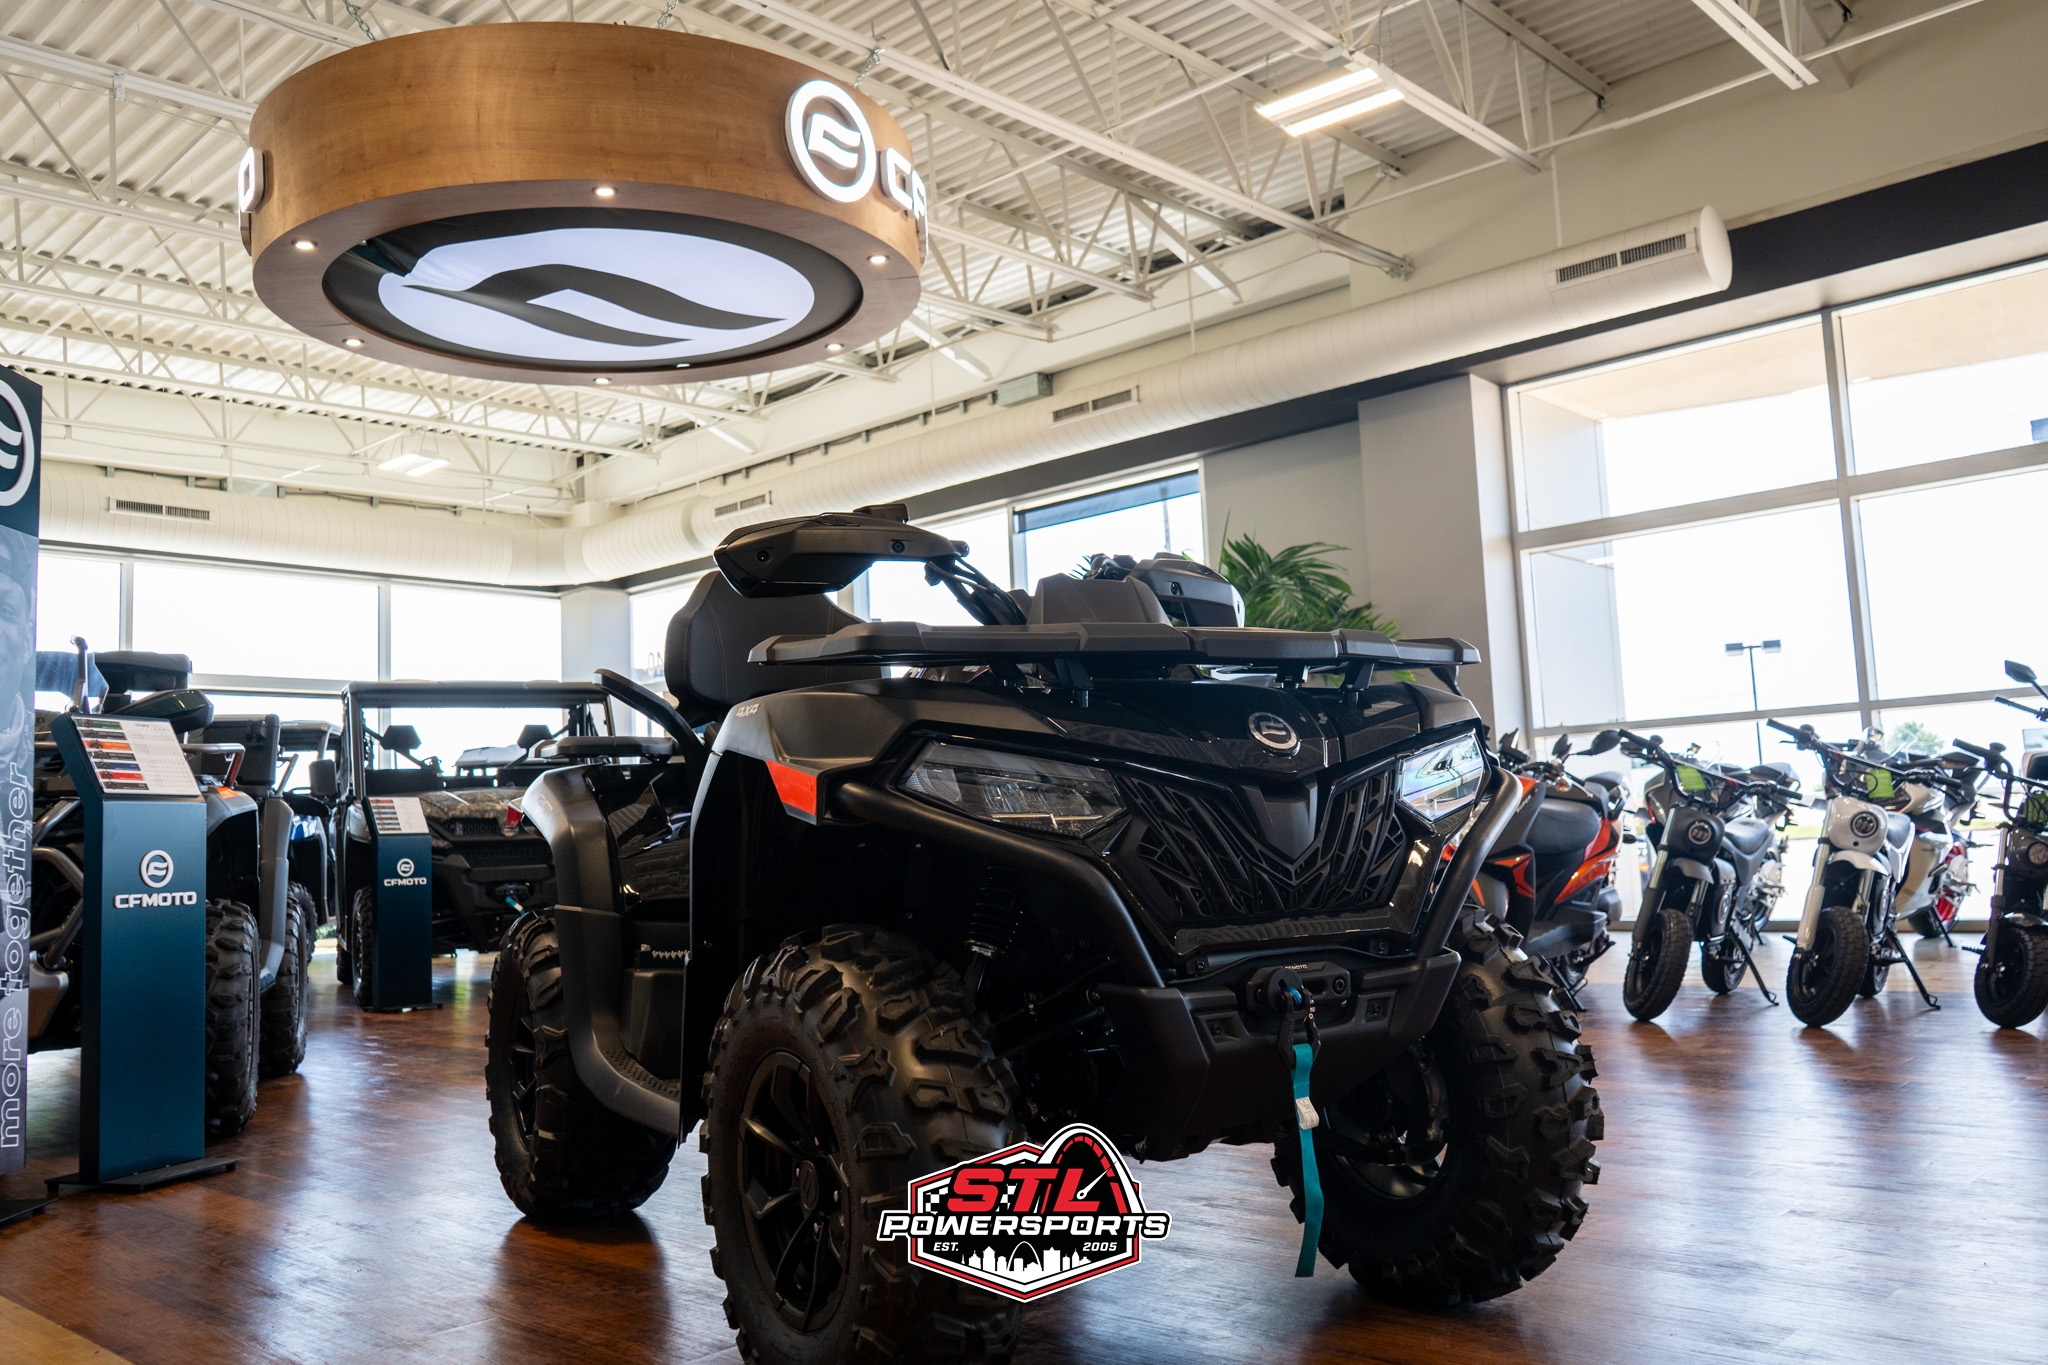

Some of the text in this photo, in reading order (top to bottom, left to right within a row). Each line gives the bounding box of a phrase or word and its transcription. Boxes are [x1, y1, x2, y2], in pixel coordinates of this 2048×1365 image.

[385, 877, 427, 886] CFMOTO
[114, 891, 197, 909] CFMOTO
[0, 761, 31, 1148] more together
